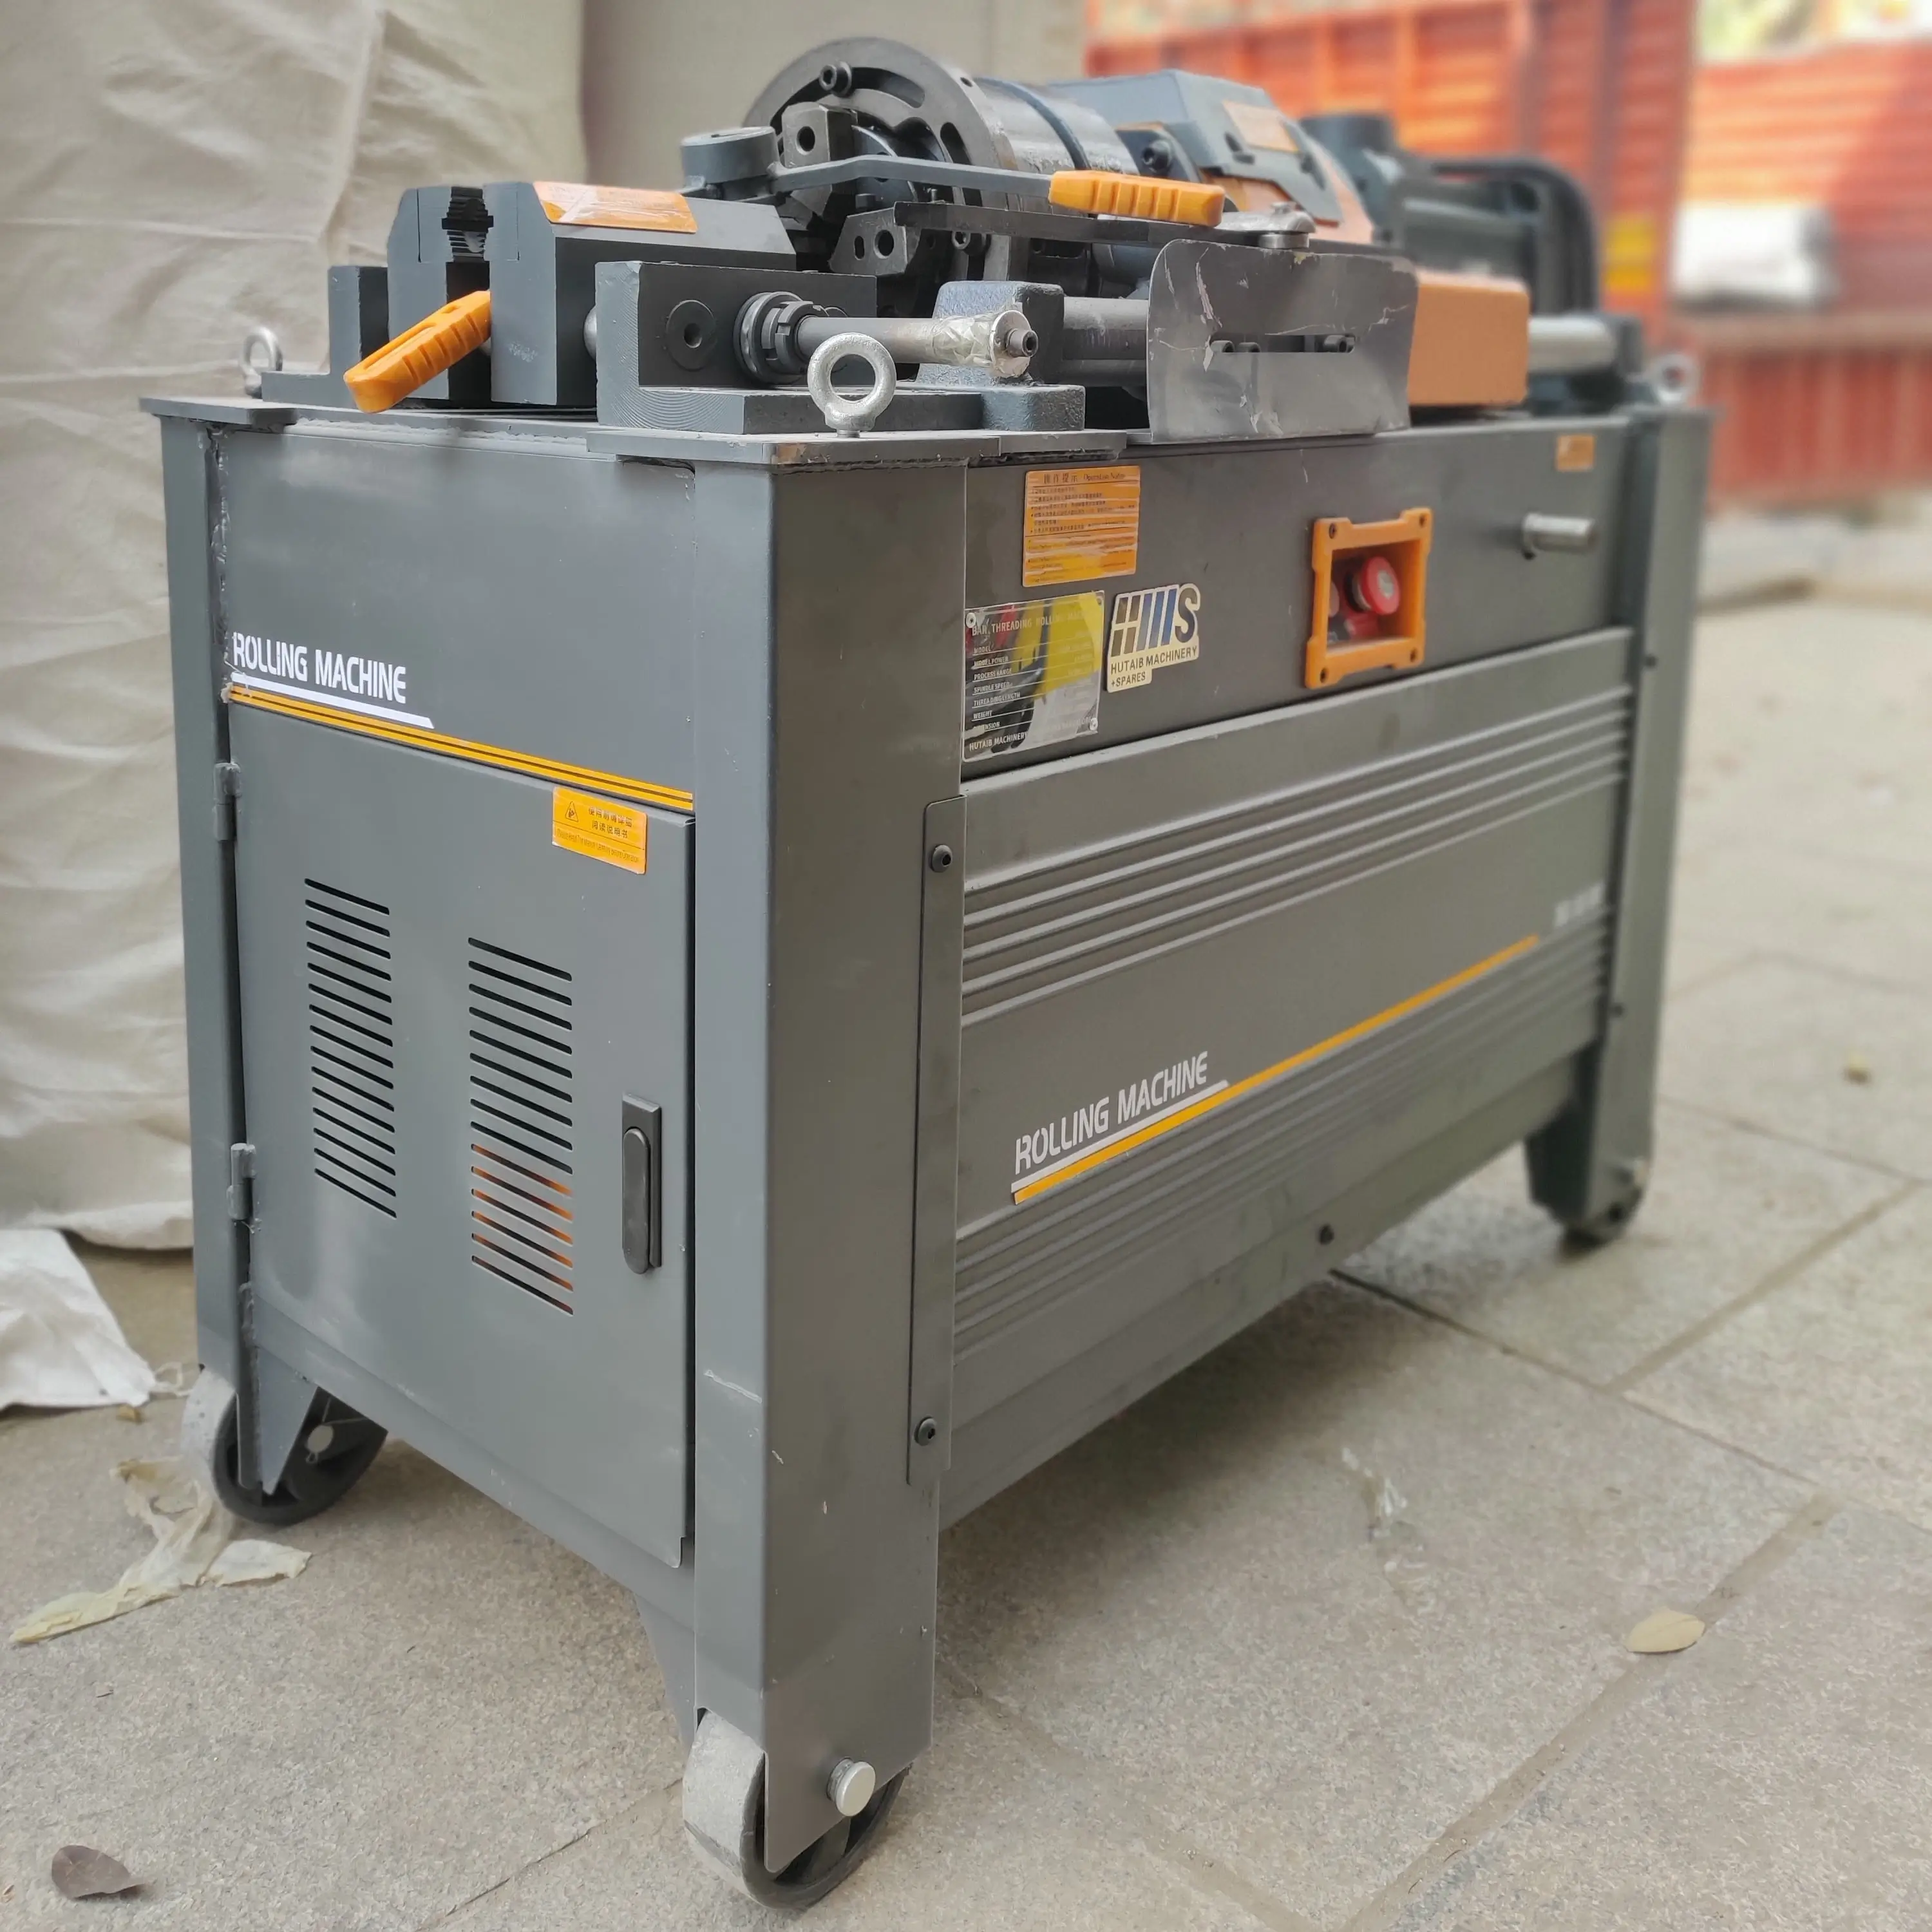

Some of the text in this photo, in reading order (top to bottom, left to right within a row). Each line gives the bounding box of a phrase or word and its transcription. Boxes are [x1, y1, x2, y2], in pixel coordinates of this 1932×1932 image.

[991, 618, 1032, 634] THREADING
[974, 645, 991, 654] MODEL
[232, 632, 406, 704] ROLLING MACHINE
[1111, 658, 1144, 675] HUTAIB
[1146, 646, 1197, 667] MACHINERY
[974, 670, 996, 681] PROCESS
[974, 683, 995, 694] SPINDLE
[973, 710, 993, 719] WEIGHT
[969, 732, 1028, 752] HUTAIB MACHINERY
[1015, 1051, 1208, 1175] ROLLING MACHINE
